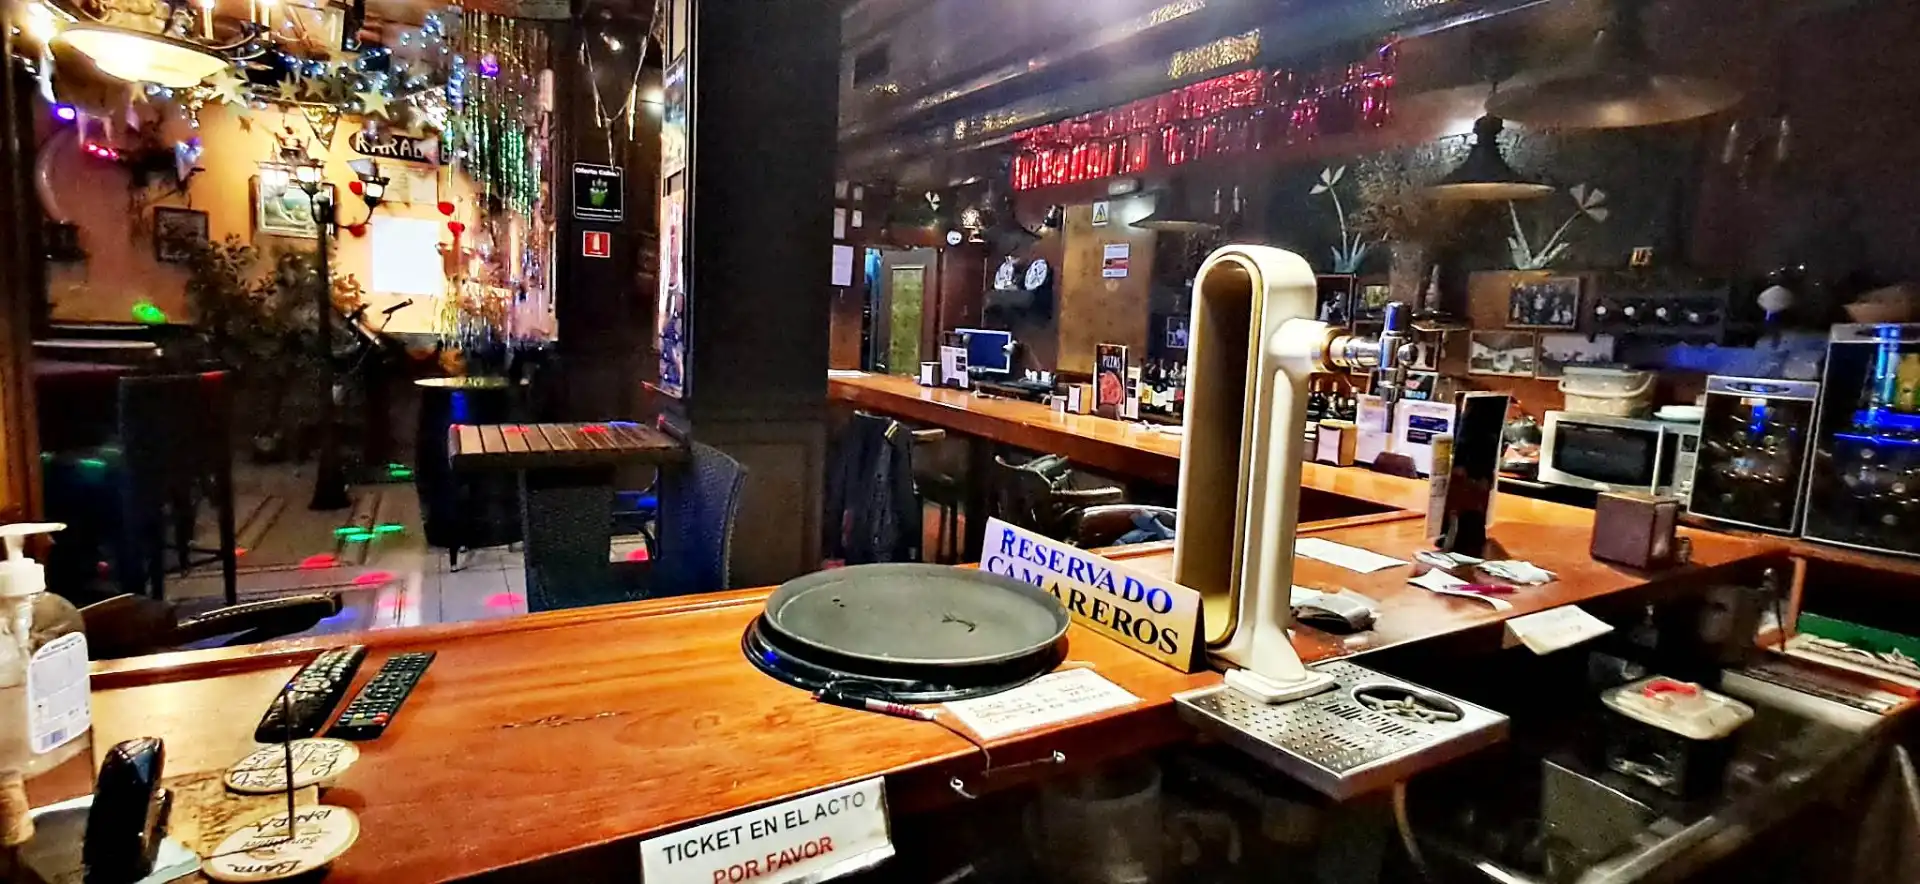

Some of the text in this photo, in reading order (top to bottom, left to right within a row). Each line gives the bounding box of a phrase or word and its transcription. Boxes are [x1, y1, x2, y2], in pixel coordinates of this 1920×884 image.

[1000, 528, 1173, 615] RESERVADO
[662, 791, 866, 865] TICKET EN EL ACTO
[713, 836, 834, 884] POR FAVOR
